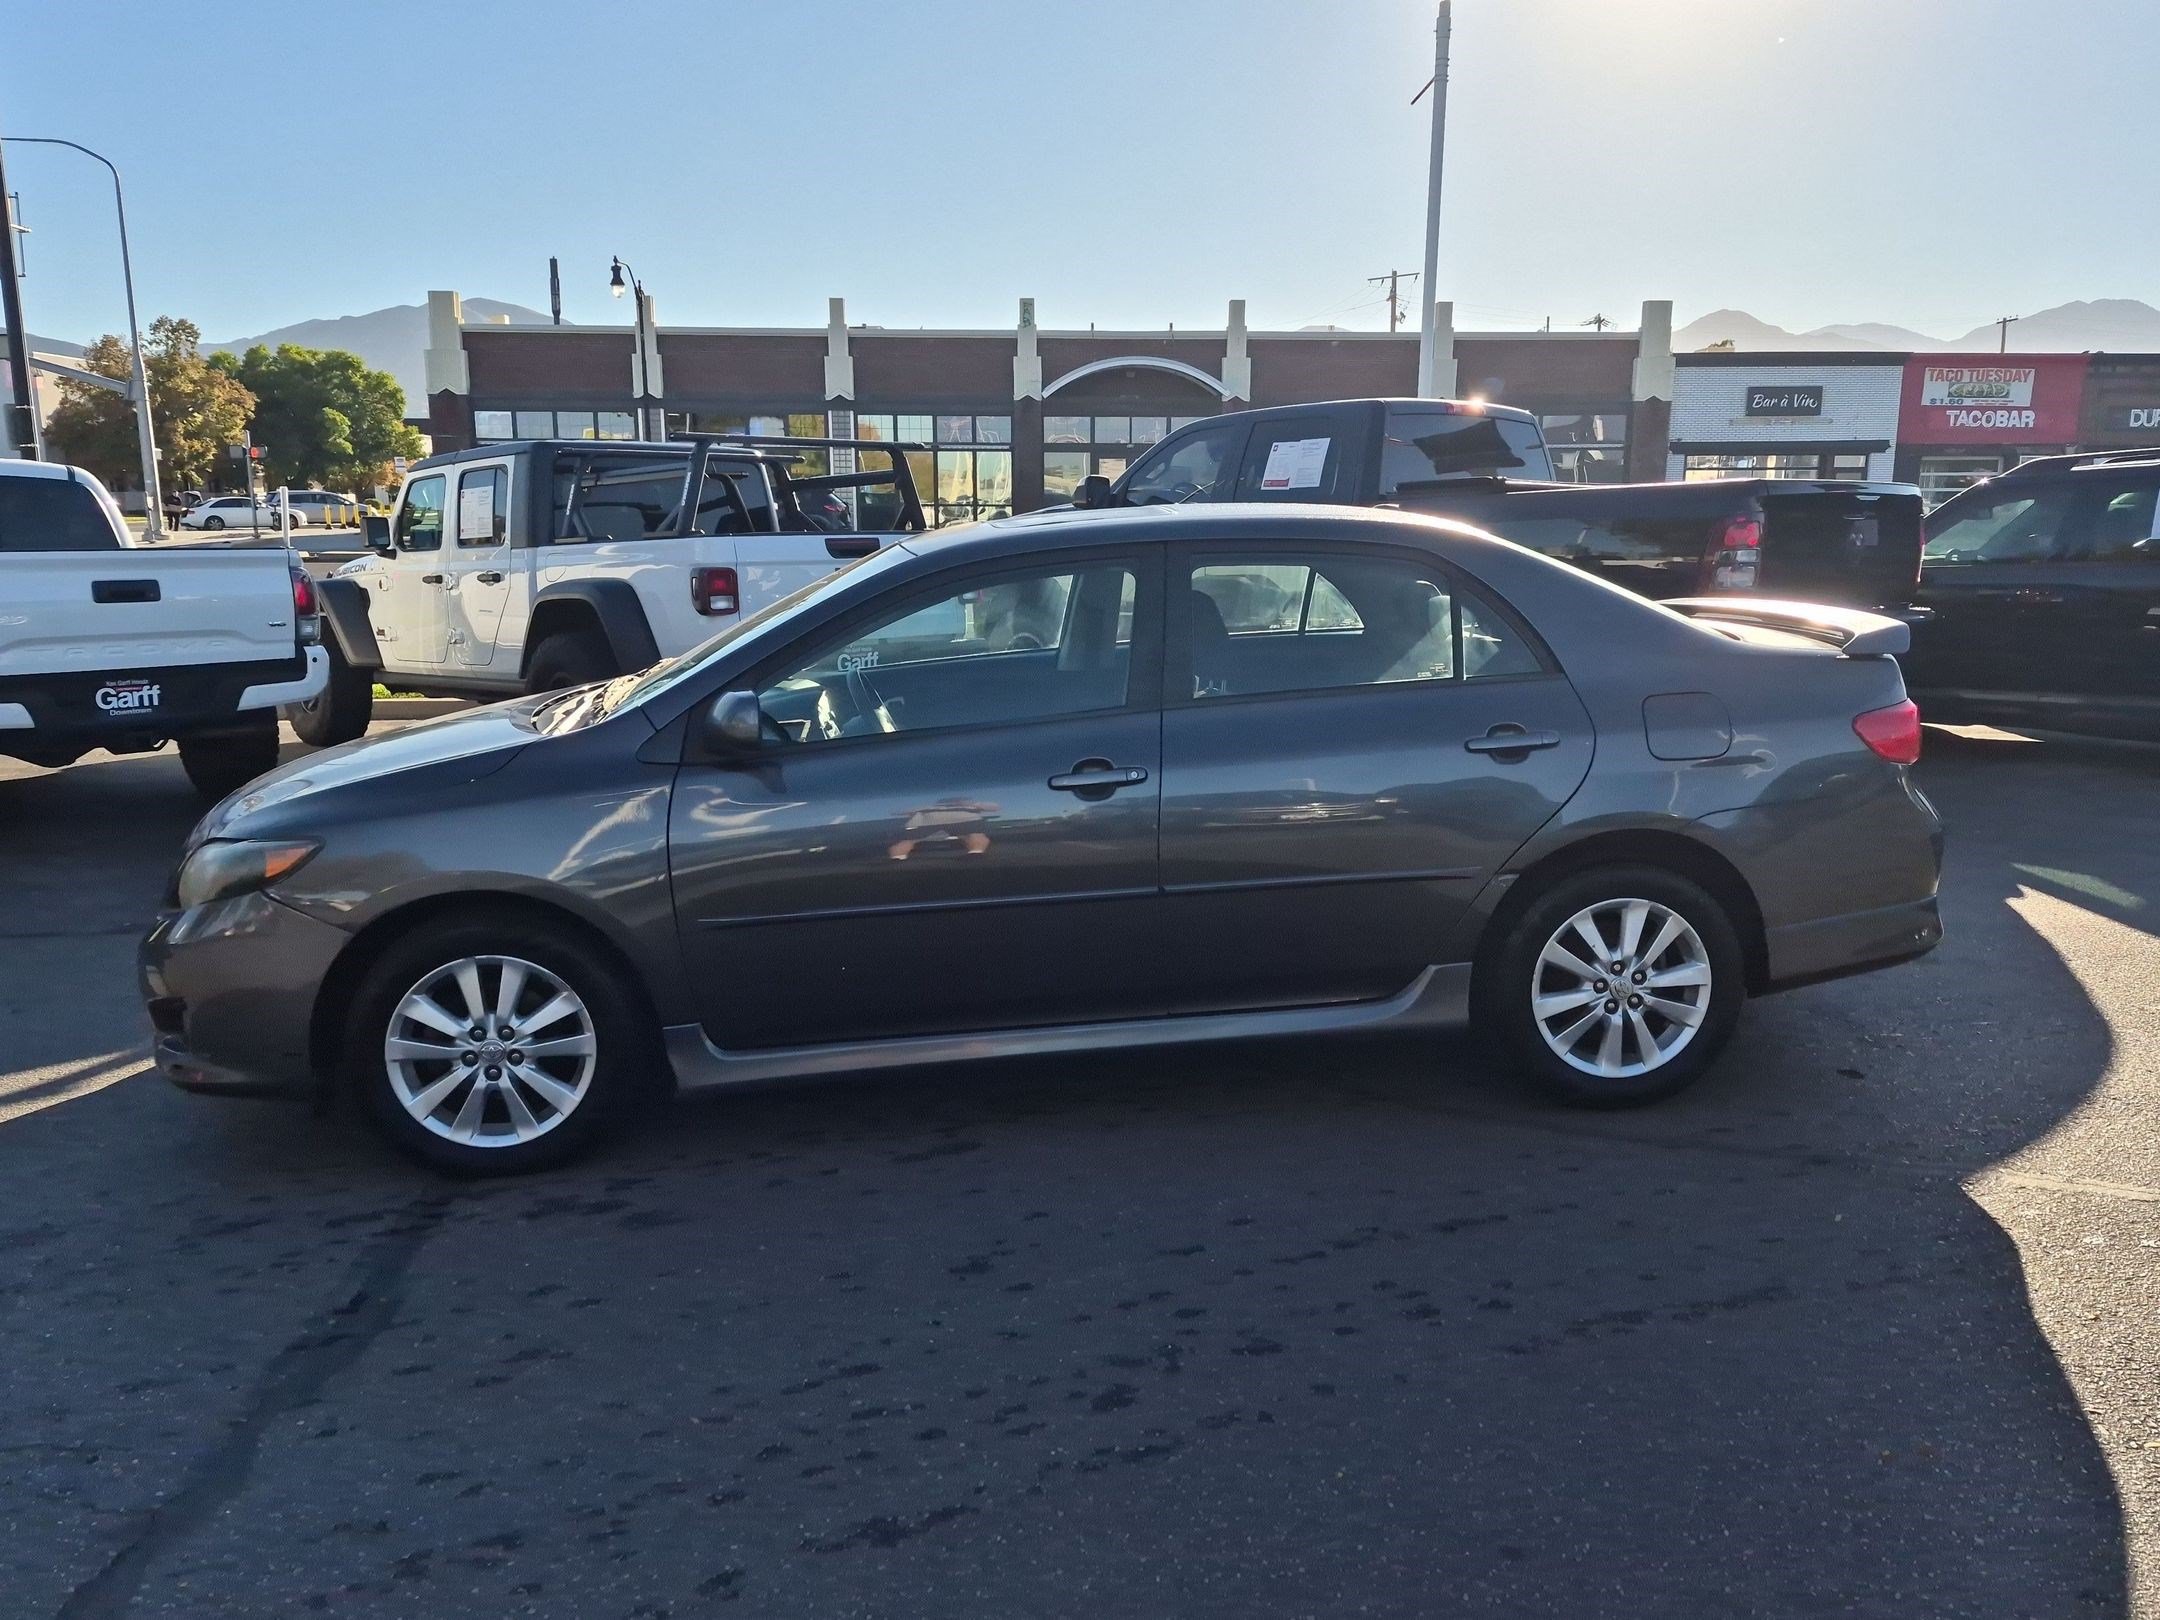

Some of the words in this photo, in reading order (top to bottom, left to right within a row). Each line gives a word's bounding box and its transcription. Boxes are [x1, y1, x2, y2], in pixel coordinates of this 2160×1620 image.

[1928, 368, 1964, 382] TACO
[1967, 369, 2033, 383] TUESDAY
[1752, 393, 1778, 408] Bar
[1780, 394, 1790, 407] à
[1793, 393, 1818, 408] Vin
[1946, 410, 2036, 428] TACOBAR
[837, 651, 879, 671] Garff
[95, 684, 160, 710] Garff
[110, 708, 153, 716] Downtown
